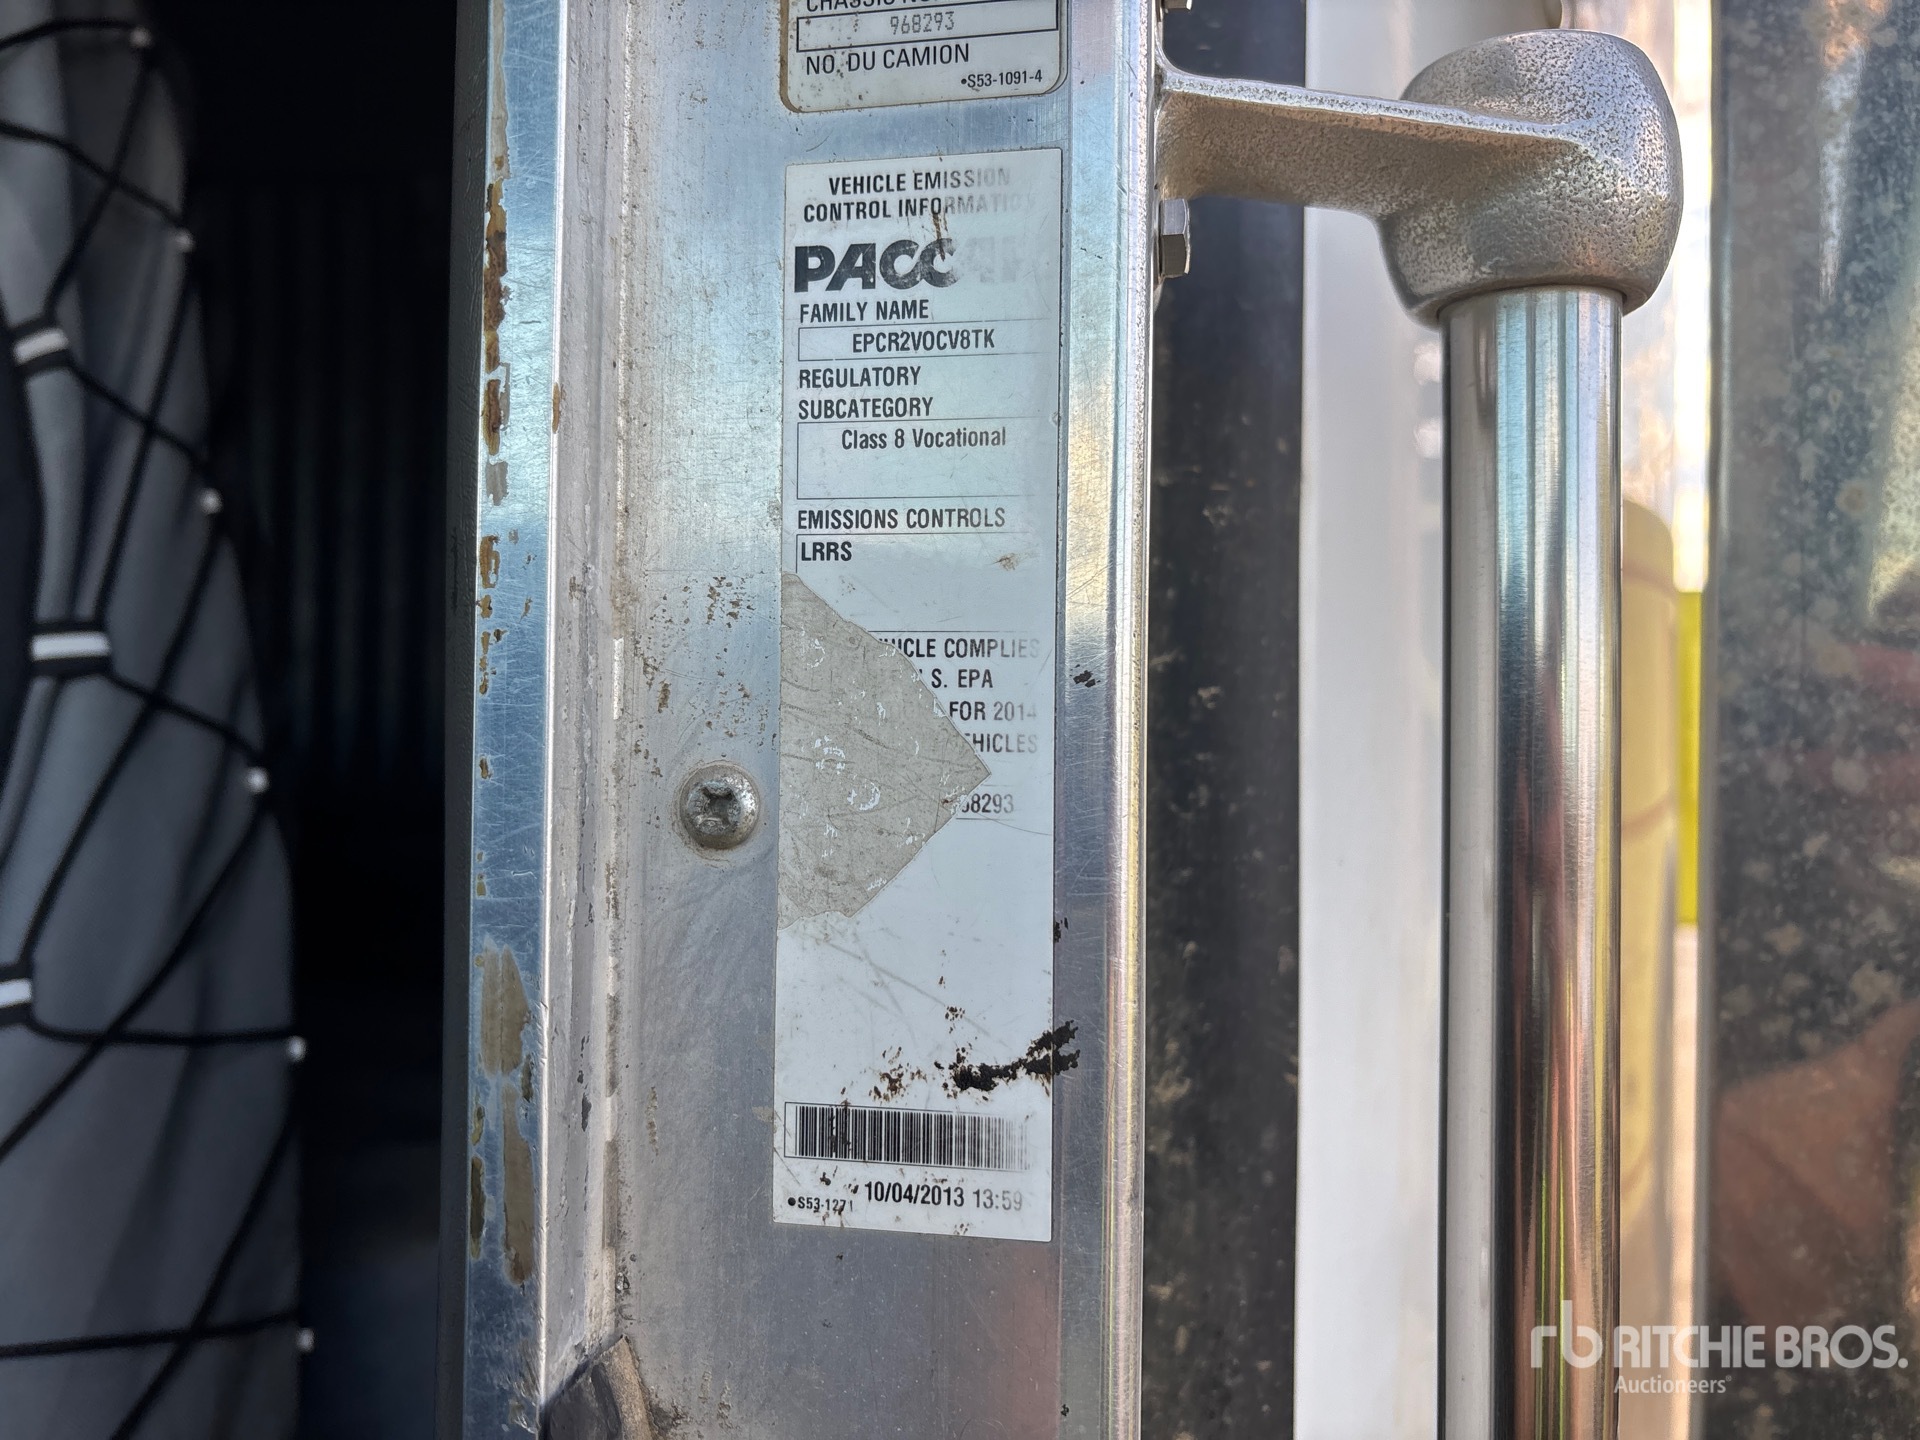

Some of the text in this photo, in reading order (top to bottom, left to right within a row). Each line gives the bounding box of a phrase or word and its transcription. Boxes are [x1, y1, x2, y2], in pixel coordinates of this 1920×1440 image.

[890, 11, 955, 35] 968293
[847, 50, 876, 72] DU
[882, 43, 970, 69] CAMION
[829, 167, 1011, 196] VEHICLE EMISSION
[803, 201, 891, 223] CONTROL
[800, 299, 930, 324] FAMILY NAME
[799, 366, 922, 389] REGULATORY
[798, 397, 934, 420] SUBCATEGORY
[841, 427, 1007, 450] Class 8 Vocational
[798, 507, 1006, 530] EMISSIONS CONTROLS
[801, 542, 853, 562] LRRS
[944, 637, 1041, 658] COMPLIES
[957, 668, 994, 689] EPA
[949, 701, 1037, 722] FOR 2014
[964, 732, 1038, 753] HICLES
[961, 793, 1014, 814] 8293
[864, 1181, 1023, 1211] 10/04/2013 13:59
